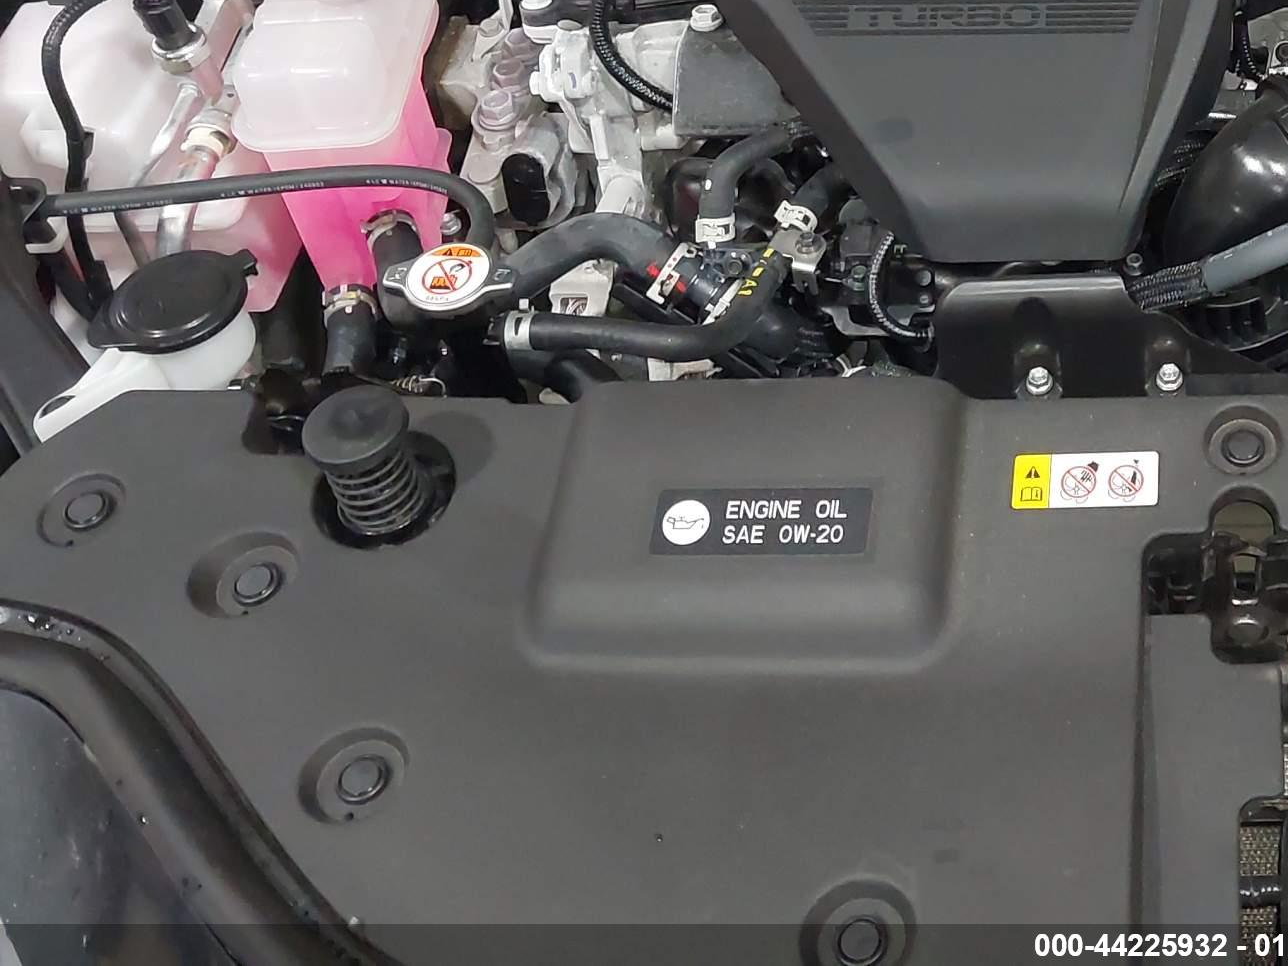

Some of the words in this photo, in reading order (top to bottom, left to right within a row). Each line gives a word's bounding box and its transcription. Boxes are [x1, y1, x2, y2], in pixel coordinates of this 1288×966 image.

[854, 6, 1042, 27] TURBO
[725, 499, 802, 519] ENGINE
[815, 499, 847, 519] OIL
[722, 524, 765, 544] SAE
[779, 524, 844, 544] 0W-20
